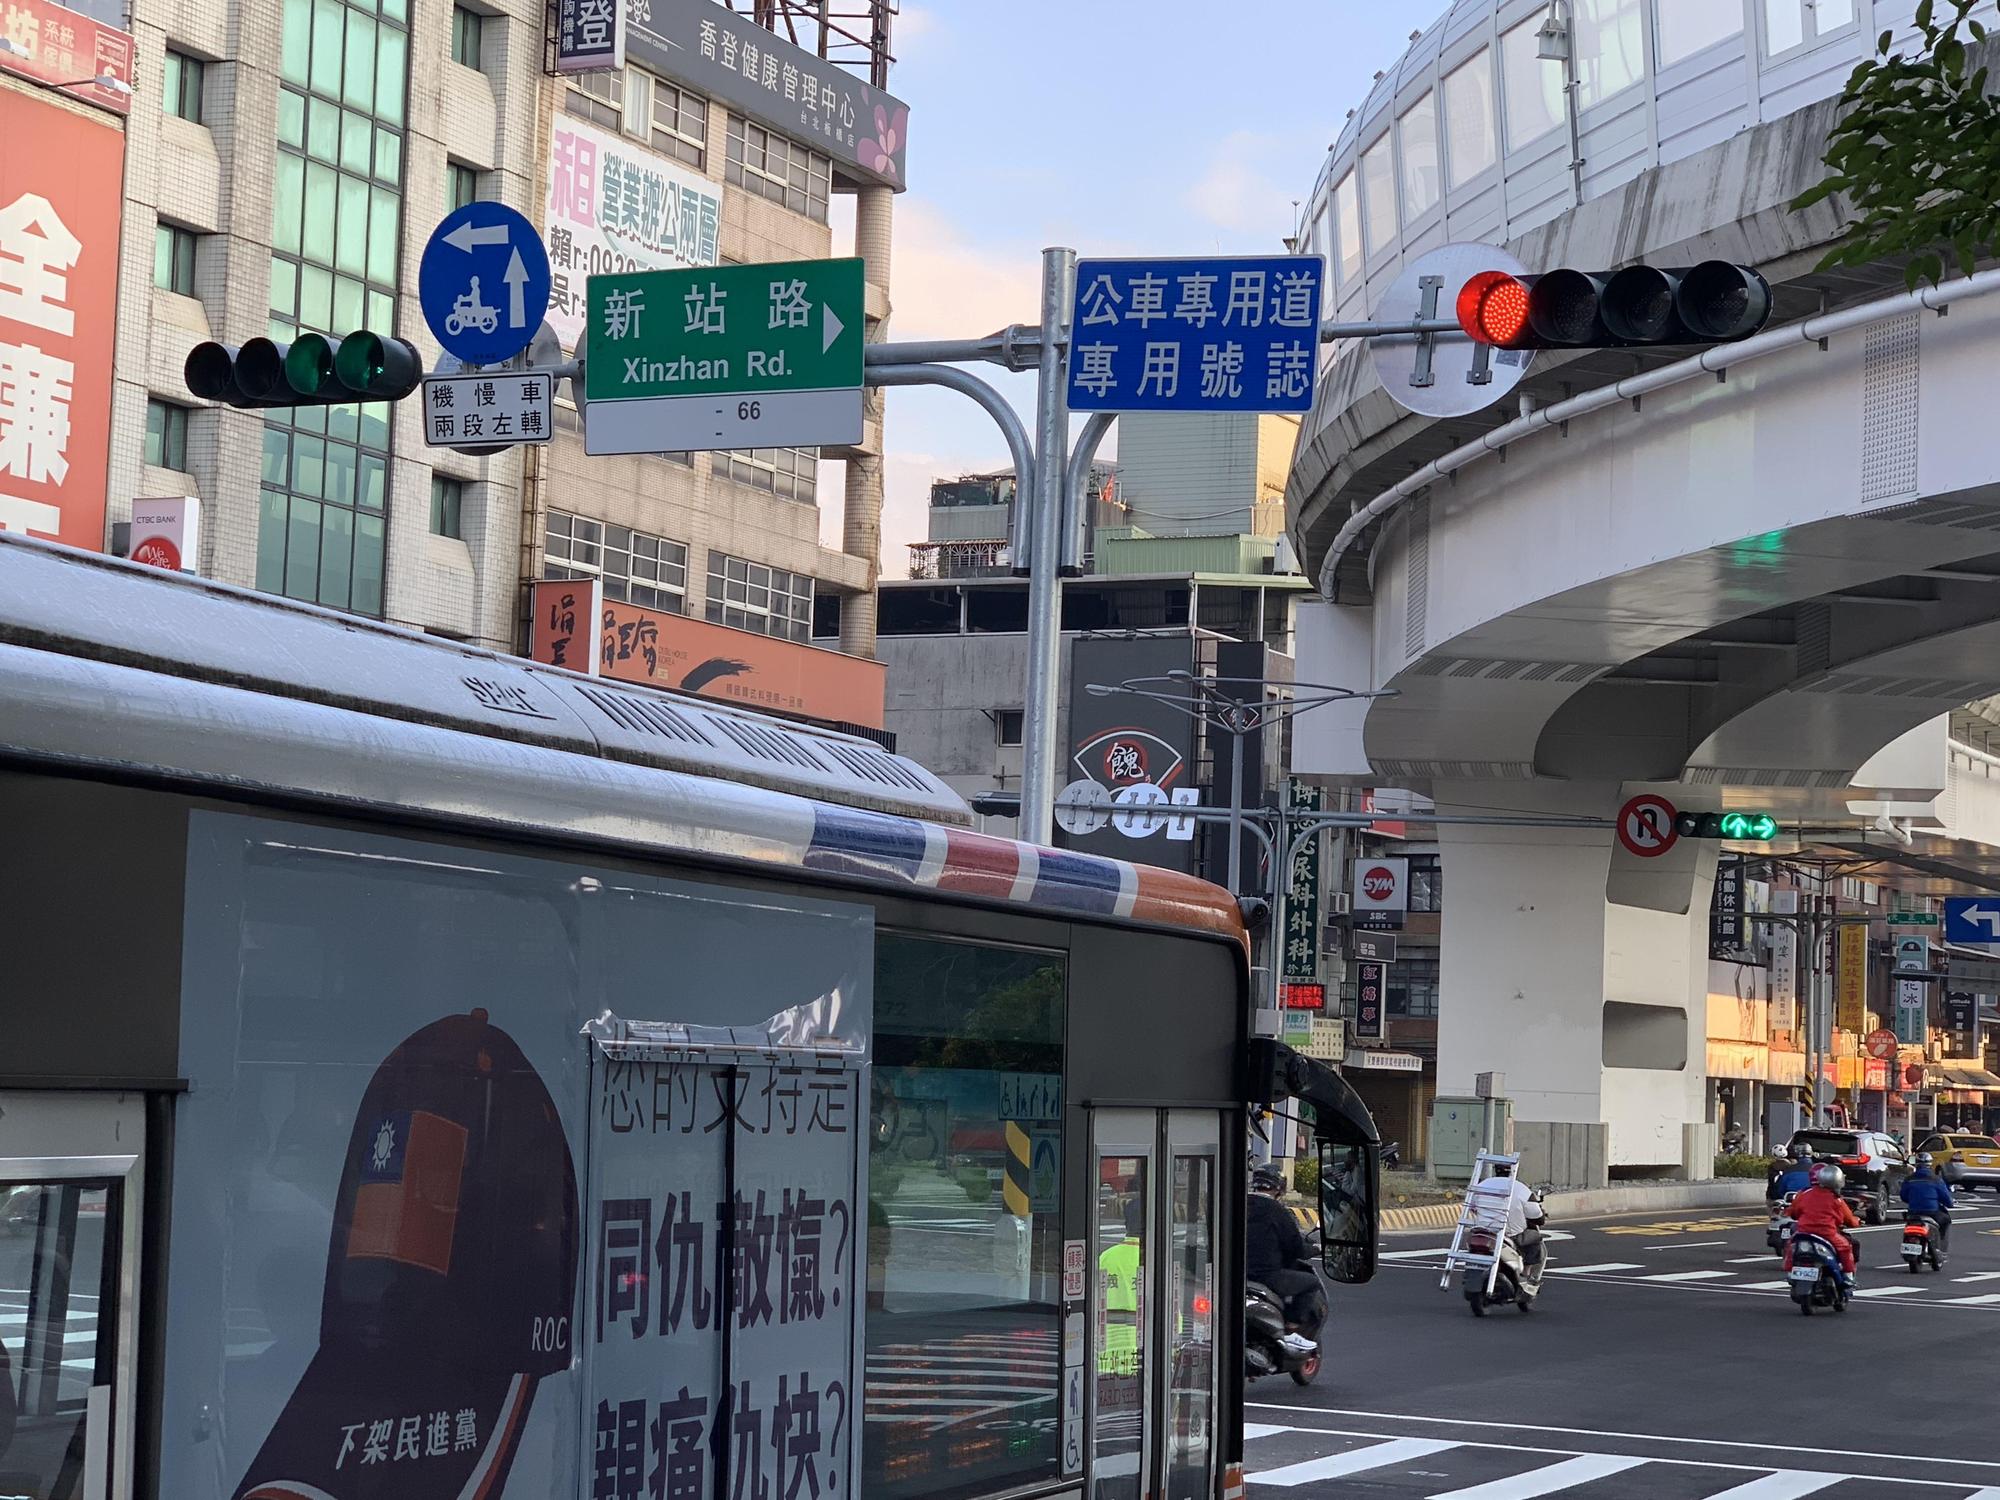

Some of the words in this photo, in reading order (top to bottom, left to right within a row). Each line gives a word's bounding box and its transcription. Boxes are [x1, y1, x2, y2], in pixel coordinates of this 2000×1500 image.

[45, 19, 75, 48] 系統
[700, 19, 855, 129] 喬登健康管理中心
[800, 111, 855, 148] 台北板橋店
[551, 129, 597, 229] 租
[604, 278, 813, 341] 新站路
[1080, 270, 1316, 330] 公車專用道
[622, 355, 729, 384] Xinzhan
[747, 350, 793, 377] Rd.
[1074, 340, 1310, 399] 專用號誌
[432, 380, 542, 409] 機慢車
[738, 401, 761, 420] 66
[433, 410, 543, 438] 兩段左轉
[136, 516, 155, 524] CTBC
[156, 515, 177, 524] BANK
[1363, 877, 1394, 894] SYM
[532, 1316, 568, 1352] ROC
[336, 1407, 477, 1470] 下架民進黨
